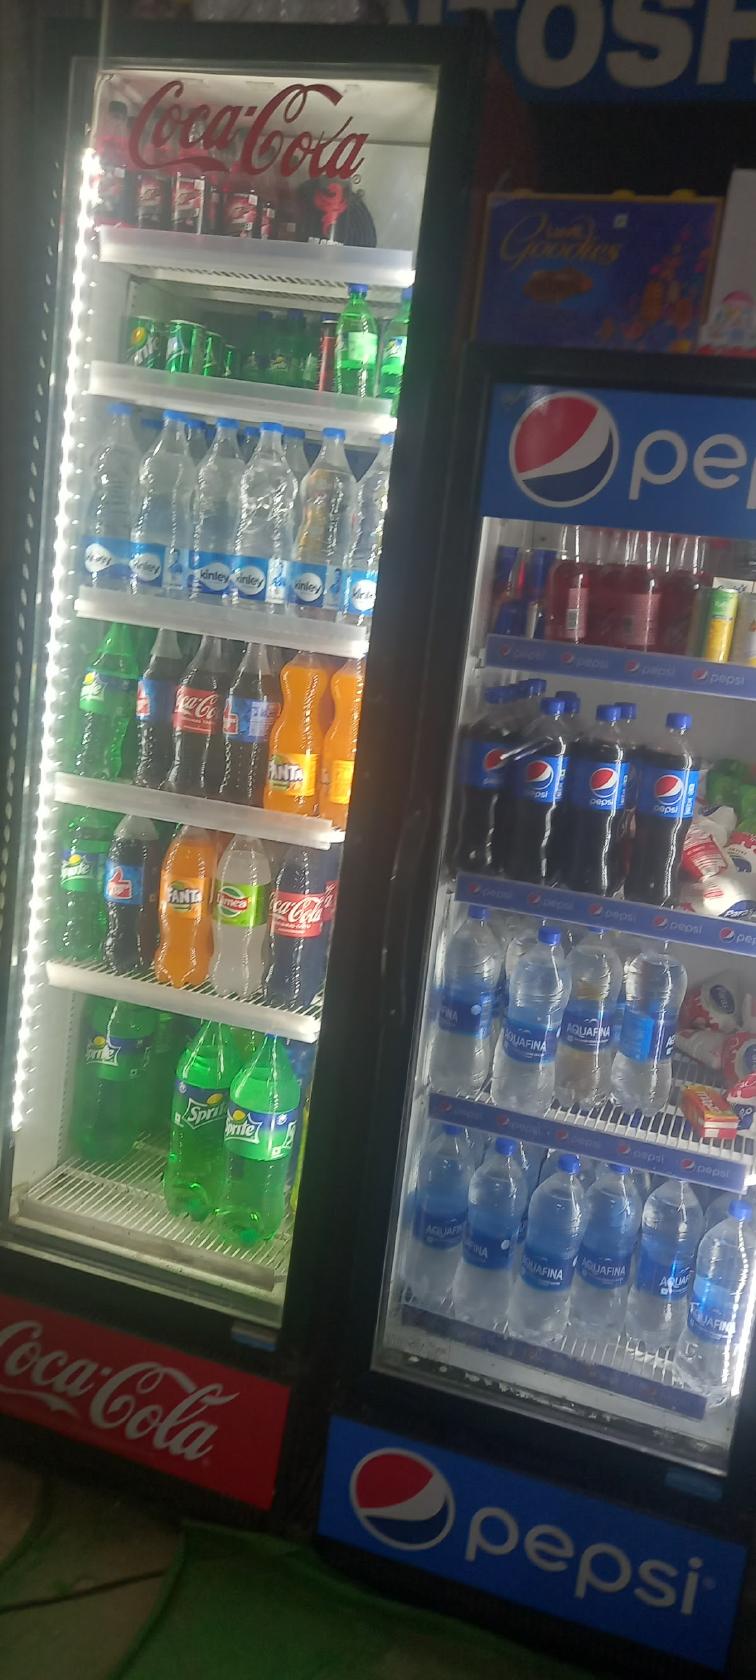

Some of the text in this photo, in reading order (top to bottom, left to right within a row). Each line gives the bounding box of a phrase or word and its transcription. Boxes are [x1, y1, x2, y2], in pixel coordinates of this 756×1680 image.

[129, 80, 369, 181] Coca-Cola
[628, 429, 756, 510] pe
[199, 568, 231, 584] kinley
[710, 672, 745, 688] pepsi
[668, 920, 704, 936] pepsi
[697, 1162, 730, 1179] pepsi
[464, 1506, 705, 1616] pepsi
